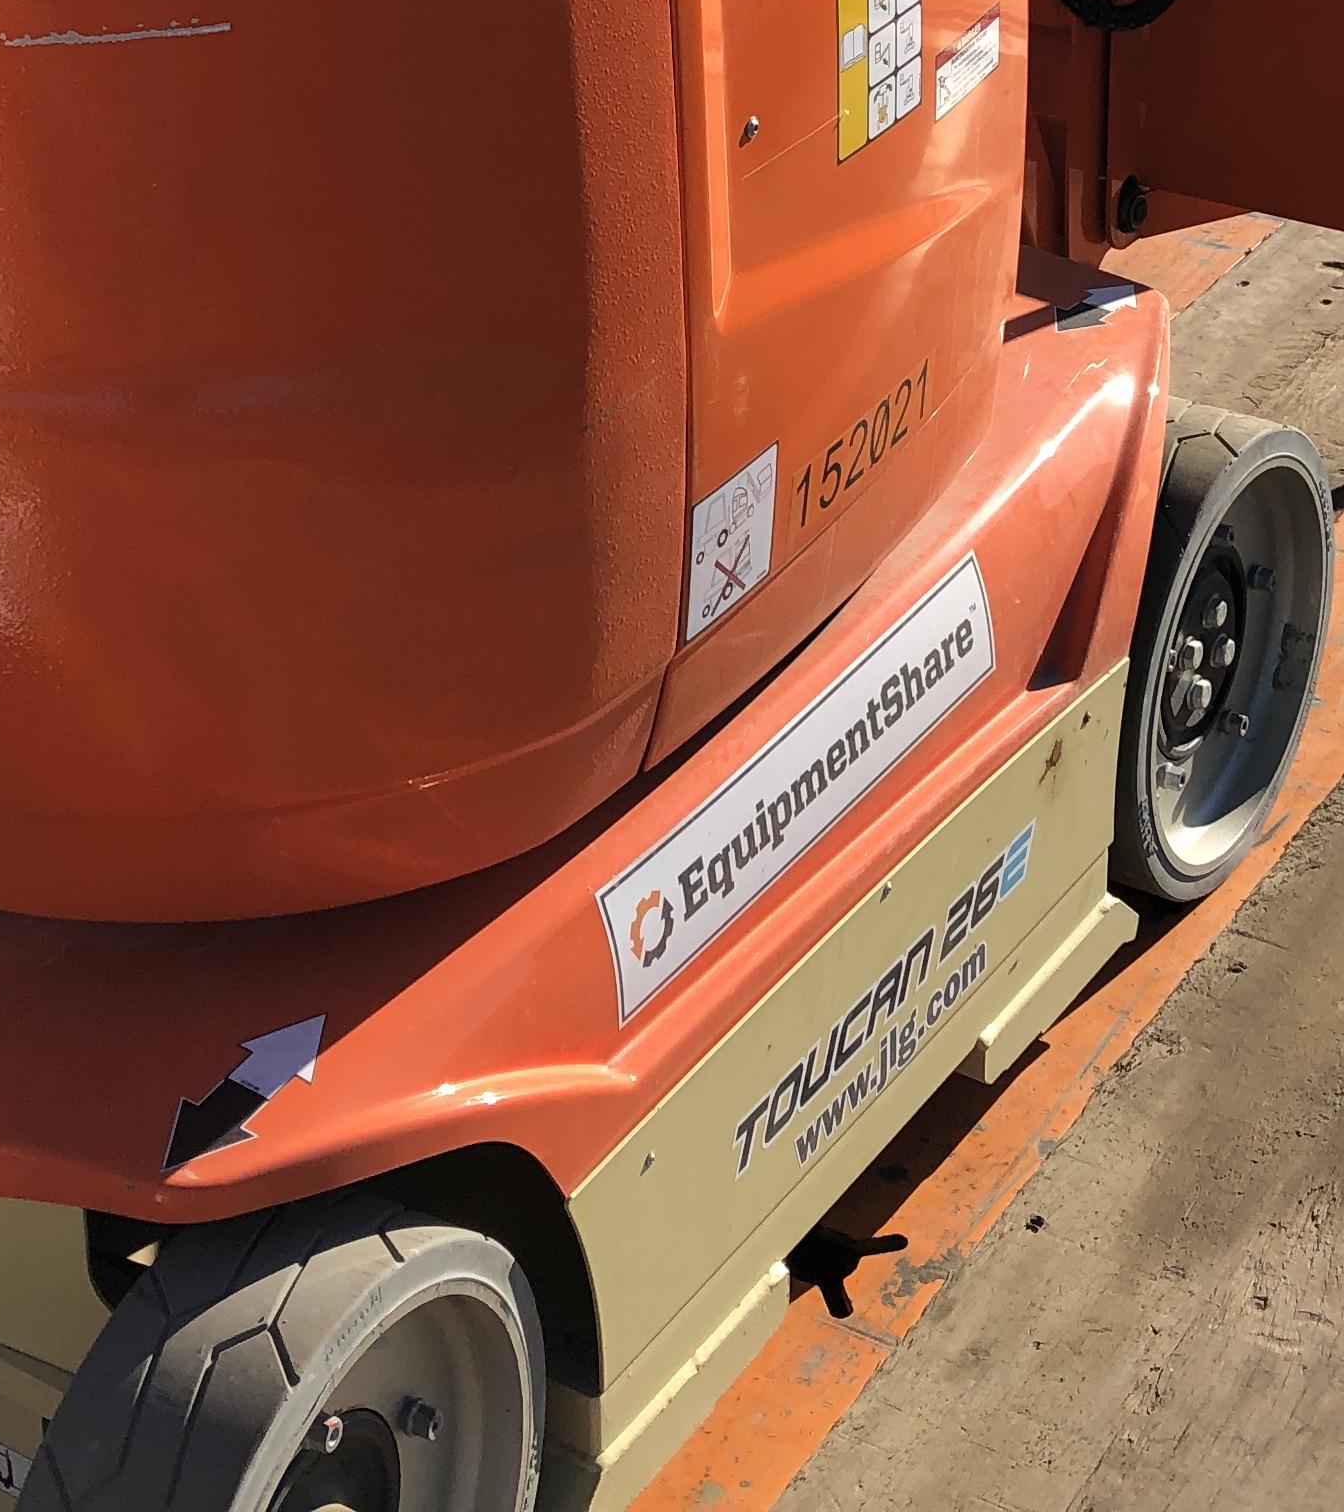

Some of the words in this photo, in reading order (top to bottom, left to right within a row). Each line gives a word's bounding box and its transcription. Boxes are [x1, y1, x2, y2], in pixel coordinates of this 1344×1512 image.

[796, 358, 929, 527] 152021
[677, 618, 975, 922] EquipmentShare
[735, 926, 935, 1176] TOUCAN
[795, 943, 987, 1165] www.jlg.com
